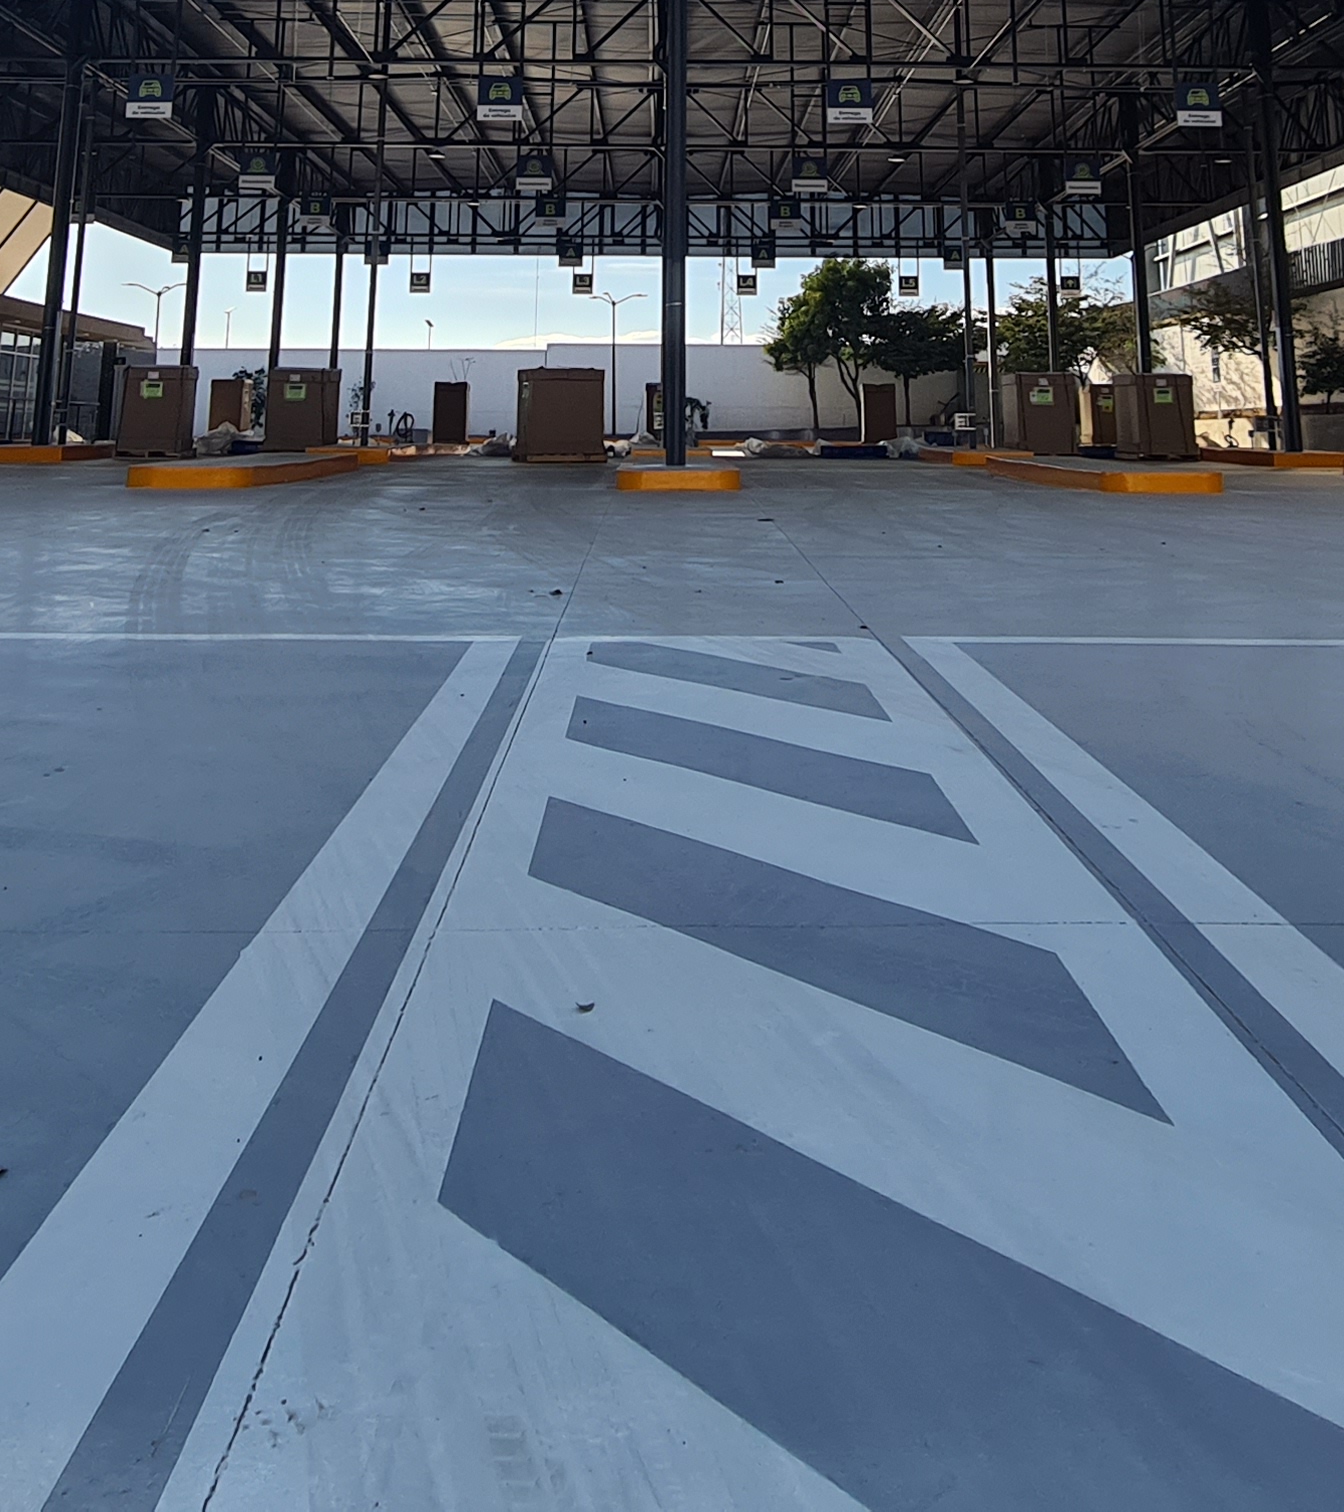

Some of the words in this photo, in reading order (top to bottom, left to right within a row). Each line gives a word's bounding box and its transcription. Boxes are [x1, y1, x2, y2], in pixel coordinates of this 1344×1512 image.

[310, 202, 320, 213] B
[545, 203, 556, 215] B
[780, 206, 791, 217] B
[1015, 208, 1026, 219] B
